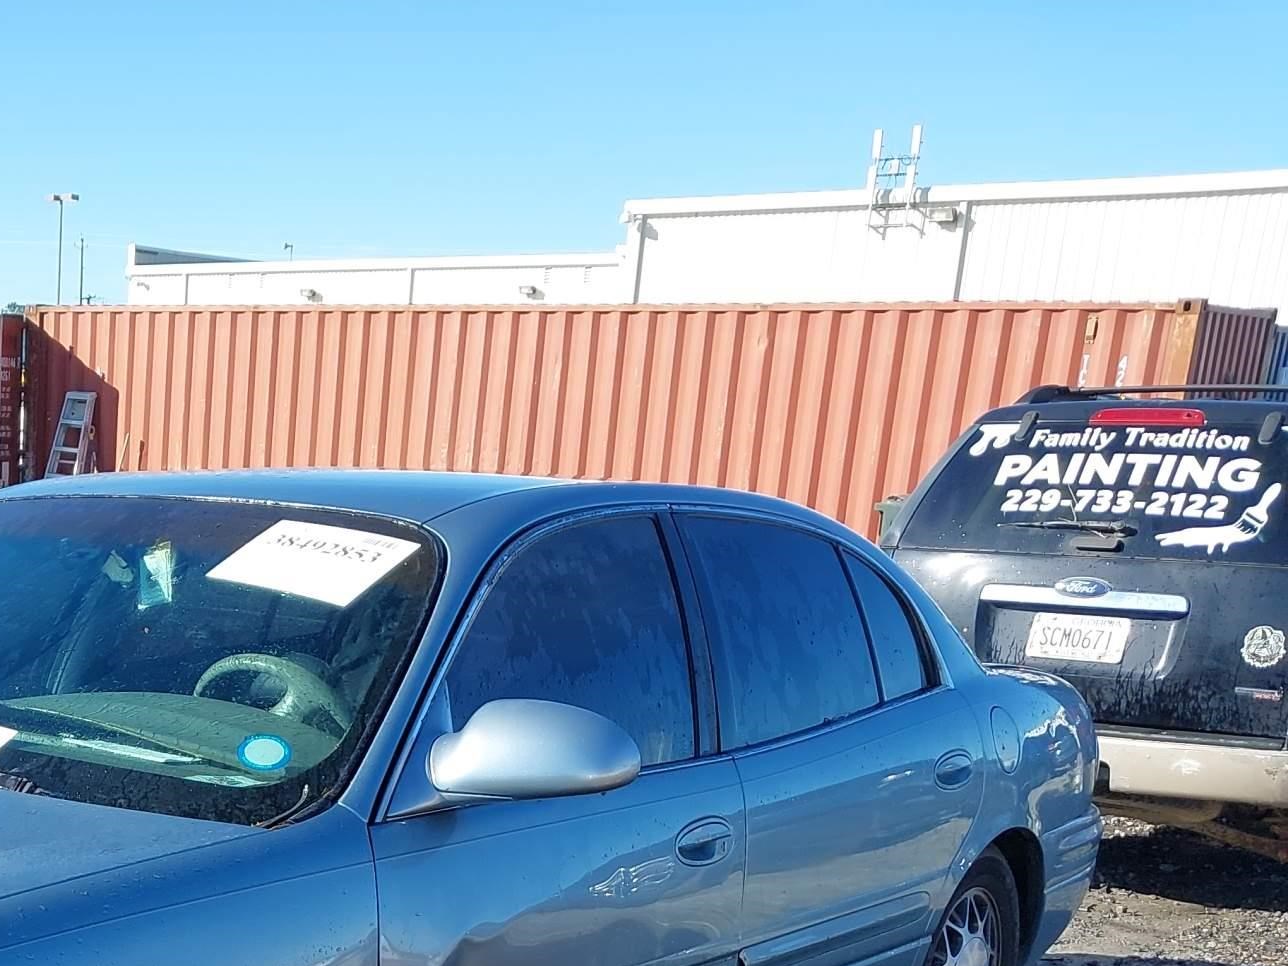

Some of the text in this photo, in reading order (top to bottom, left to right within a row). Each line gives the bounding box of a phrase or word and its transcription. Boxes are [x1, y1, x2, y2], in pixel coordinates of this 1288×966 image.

[1029, 427, 1251, 451] Family Tradition
[993, 453, 1262, 492] PAINTING
[1000, 489, 1229, 520] 229-733-2122
[267, 534, 383, 562] 38492853
[1065, 580, 1098, 593] Ford
[1039, 626, 1113, 651] SCM0671
